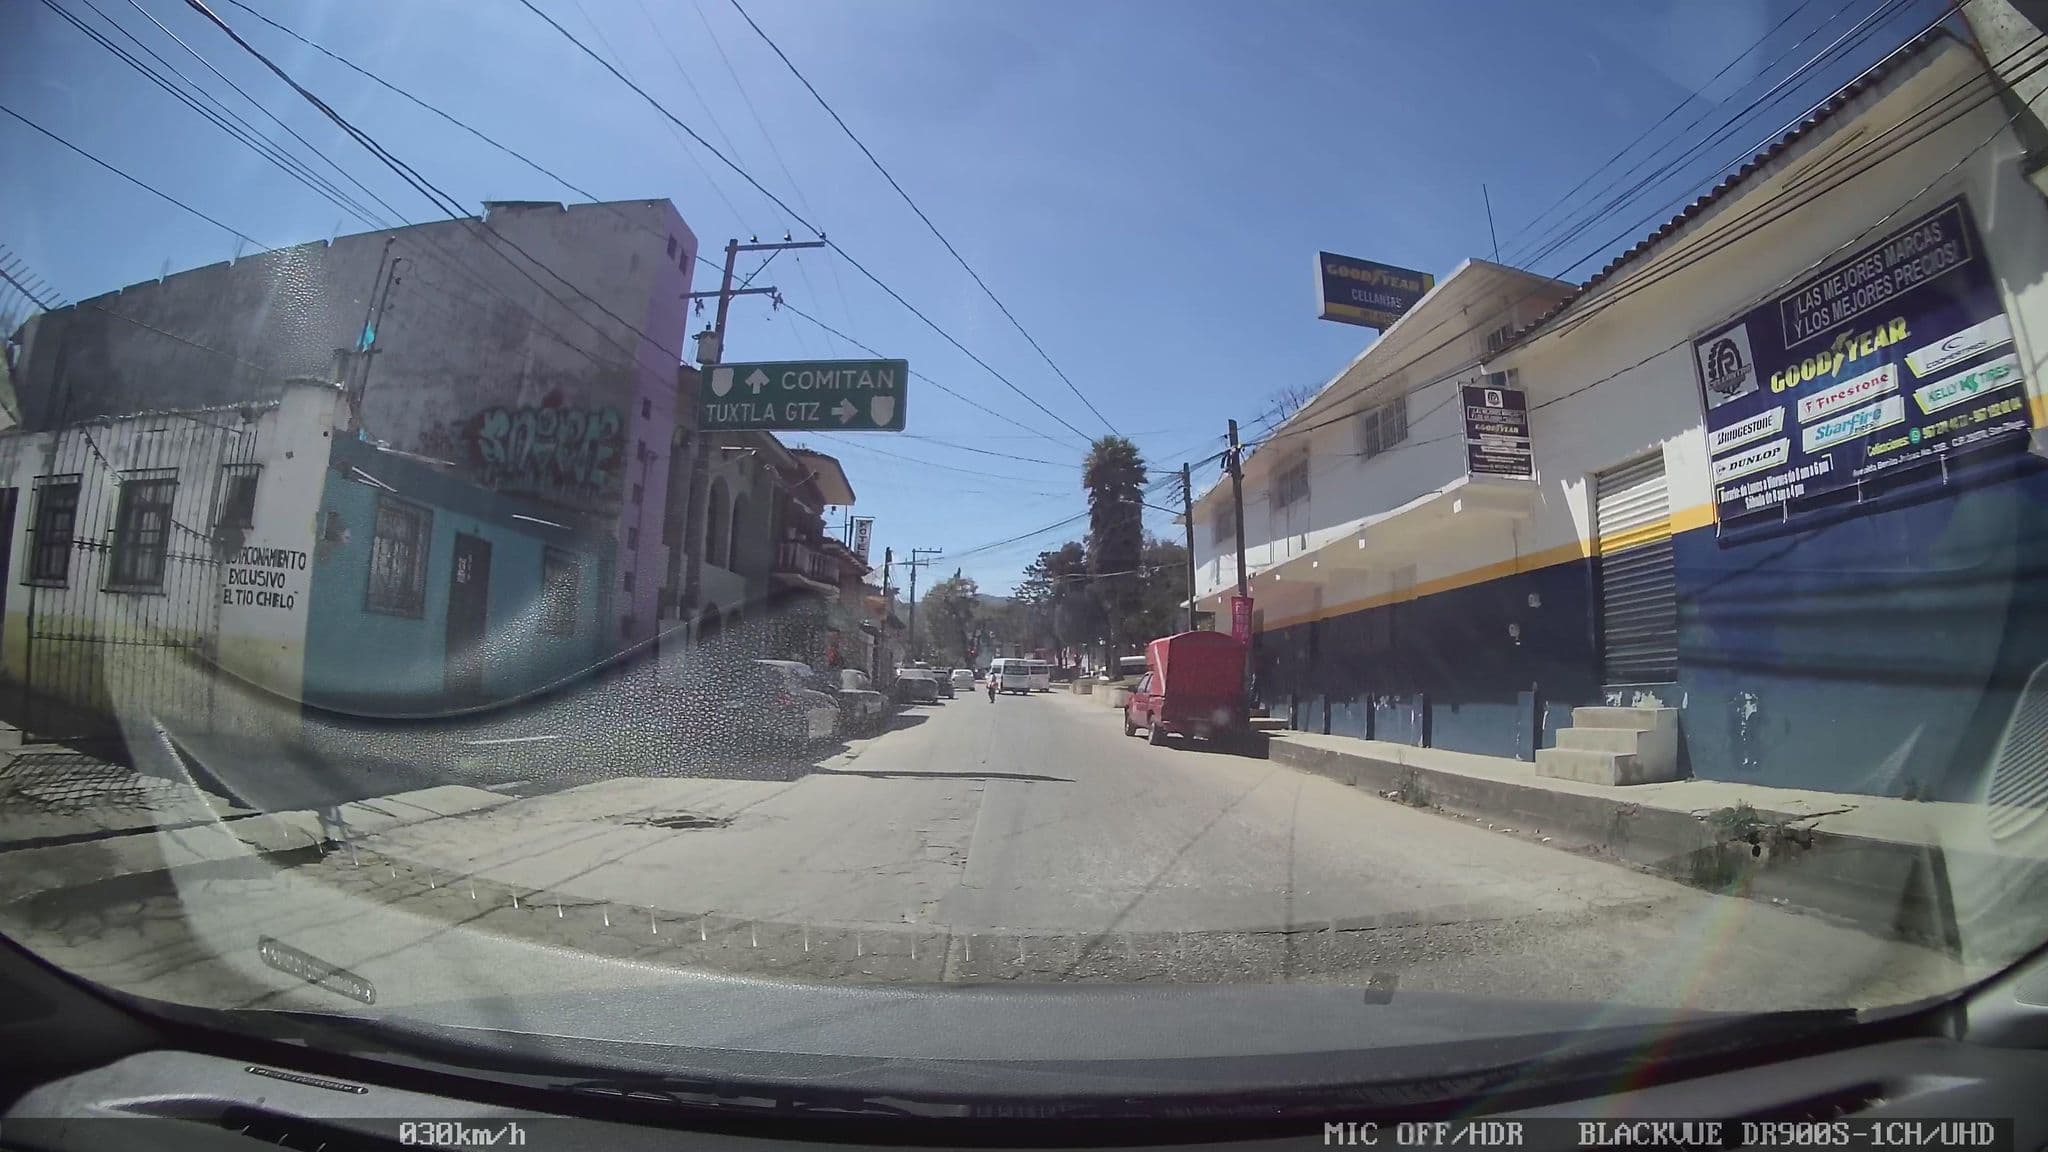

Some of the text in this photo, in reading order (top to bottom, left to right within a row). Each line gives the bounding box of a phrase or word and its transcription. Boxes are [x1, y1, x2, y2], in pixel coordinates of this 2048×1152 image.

[1823, 253, 1884, 300] MEJORES
[1884, 221, 1942, 268] MARCAS
[1326, 263, 1420, 293] GOODYEAR
[1794, 319, 1803, 339] Y
[1804, 307, 1831, 336] LOS
[1831, 274, 1894, 321] MEJORES
[1770, 315, 1909, 394] GOODYEAR
[781, 369, 894, 391] COMITAN
[1816, 373, 1889, 409] Firestone
[1928, 383, 1957, 402] KELLY
[706, 402, 820, 423] TUXTLA GTZ
[1717, 414, 1773, 446] BRIDGESTONE
[1729, 447, 1781, 472] DUNLOP
[228, 568, 286, 589] EXCLUSIVO
[235, 589, 254, 606] TIO
